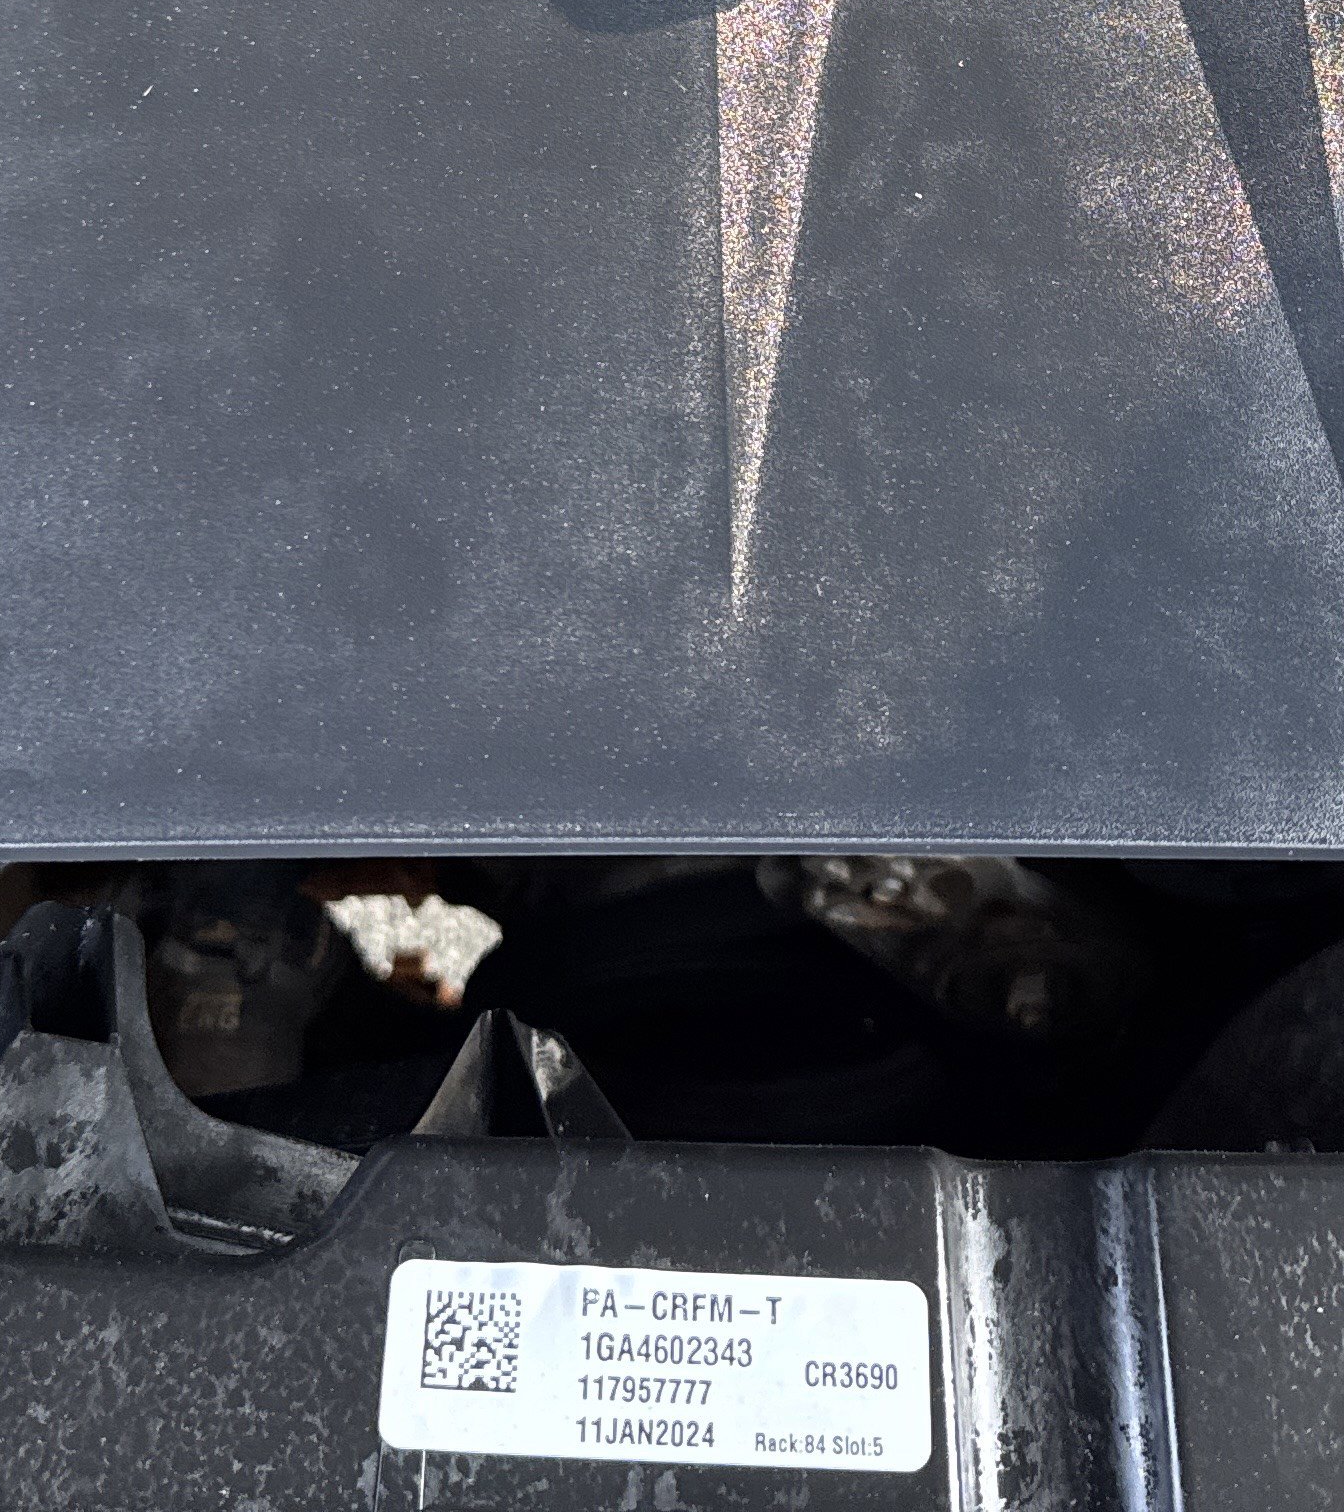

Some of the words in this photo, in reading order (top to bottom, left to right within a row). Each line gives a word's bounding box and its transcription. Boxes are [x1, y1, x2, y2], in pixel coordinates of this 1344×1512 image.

[580, 1332, 754, 1368] 1GA4602343
[576, 1375, 713, 1405] 117957777
[804, 1361, 898, 1390] CR3690
[574, 1417, 716, 1448] 11JAN2024
[754, 1431, 826, 1455] Rack:84
[832, 1434, 884, 1457] Slot:5
